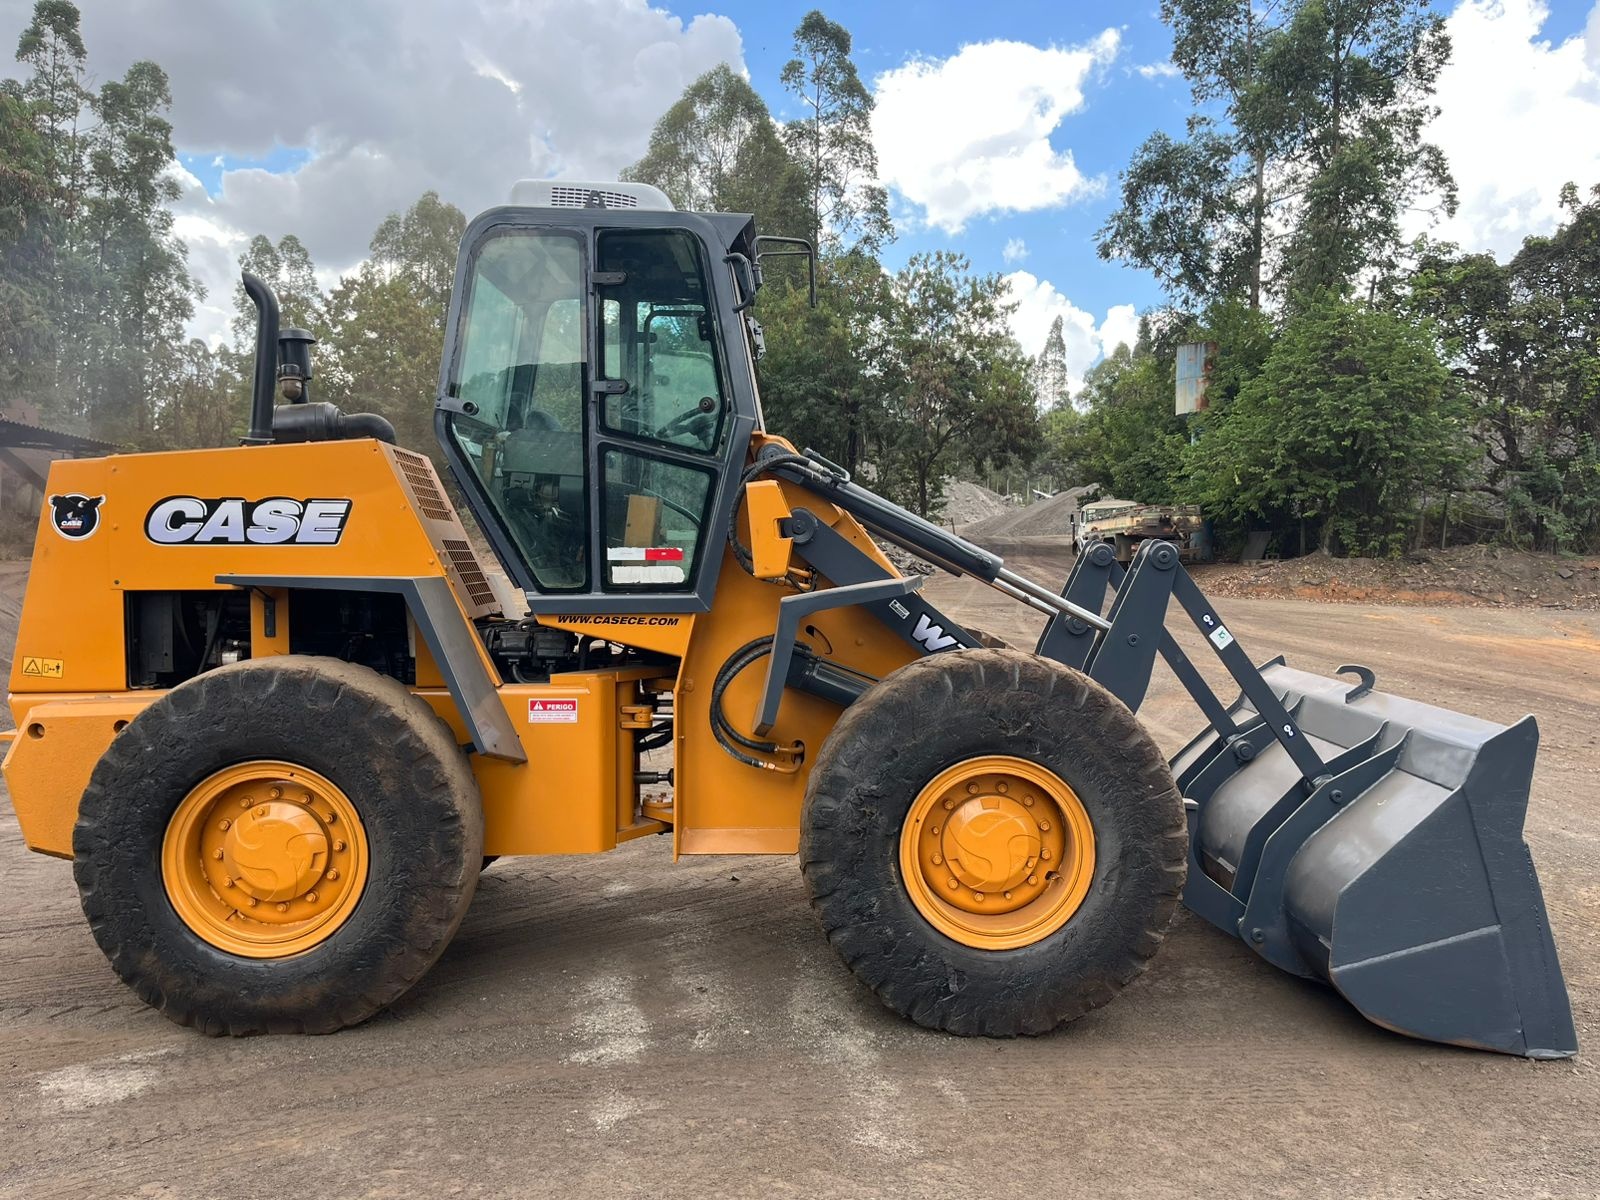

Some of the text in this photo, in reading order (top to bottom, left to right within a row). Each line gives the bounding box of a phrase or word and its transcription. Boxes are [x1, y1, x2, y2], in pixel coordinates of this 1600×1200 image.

[148, 497, 350, 543] CASE
[558, 615, 679, 626] WWW.CASECE.COM
[912, 613, 967, 652] W
[546, 703, 574, 711] PERIGO
